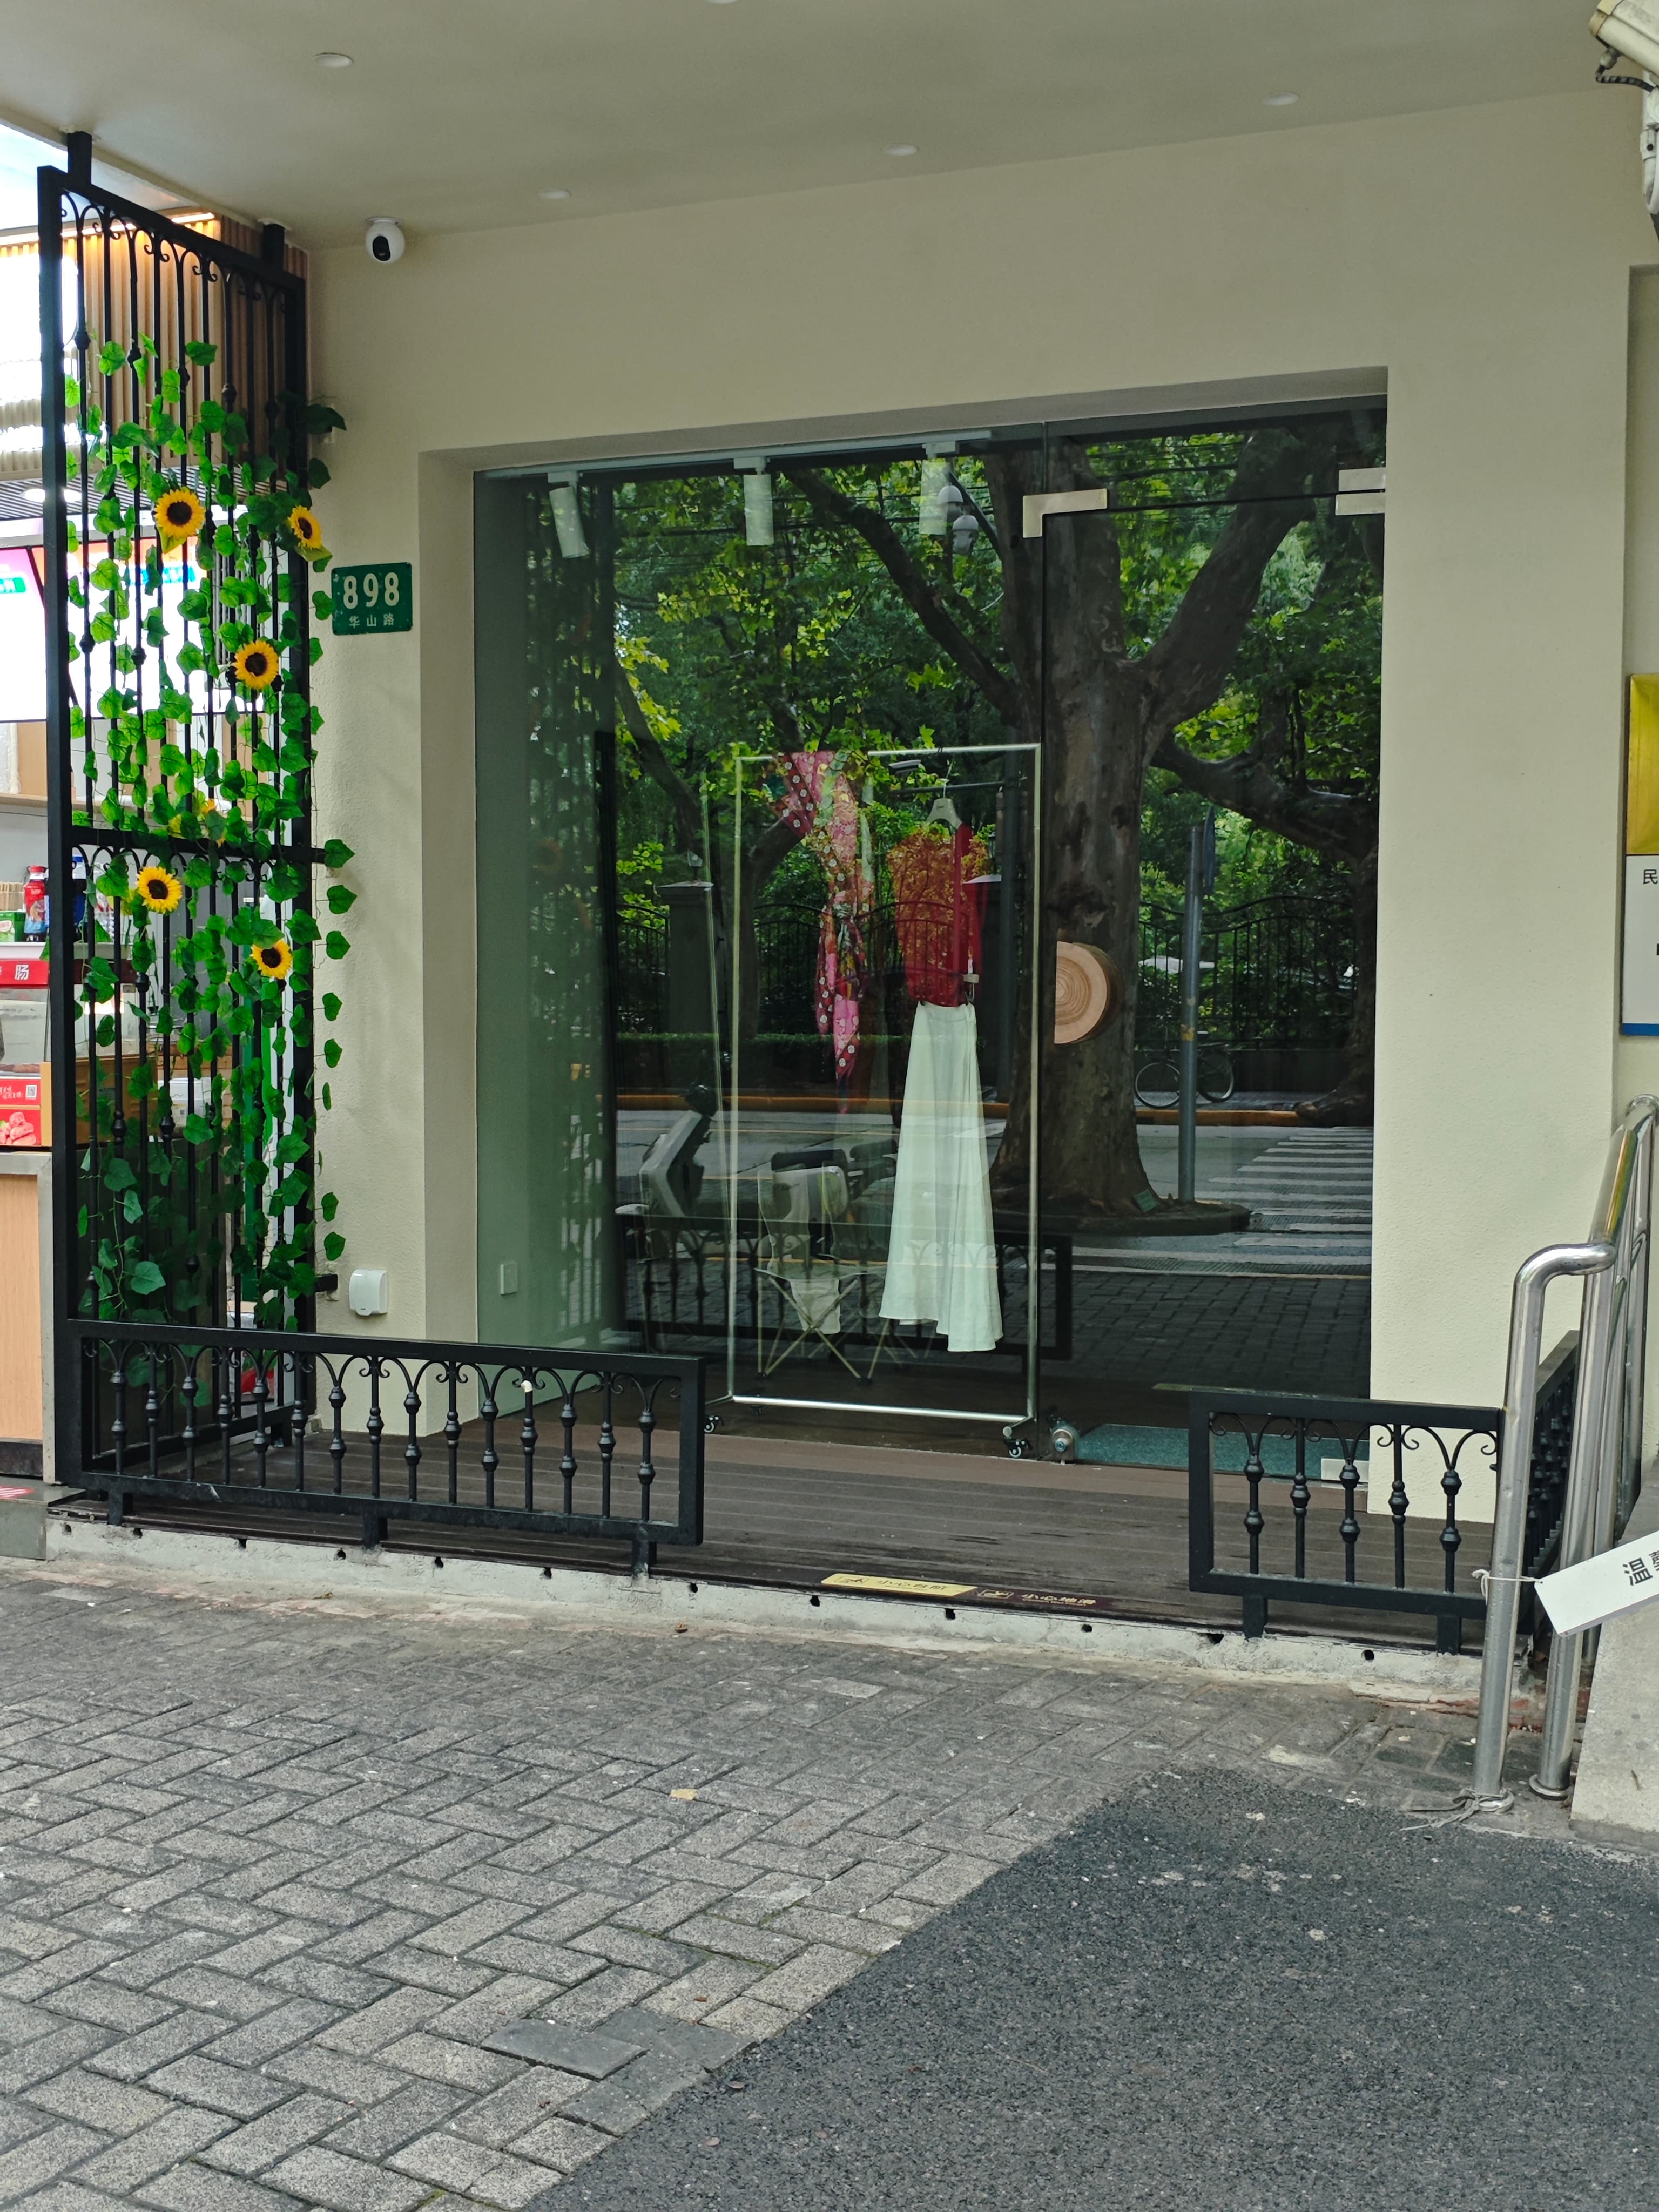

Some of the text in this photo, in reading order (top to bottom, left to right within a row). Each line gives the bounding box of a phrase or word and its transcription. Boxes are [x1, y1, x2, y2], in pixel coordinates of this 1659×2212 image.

[343, 572, 400, 609] 898
[349, 613, 394, 628] 华山路
[1643, 869, 1659, 885] 民
